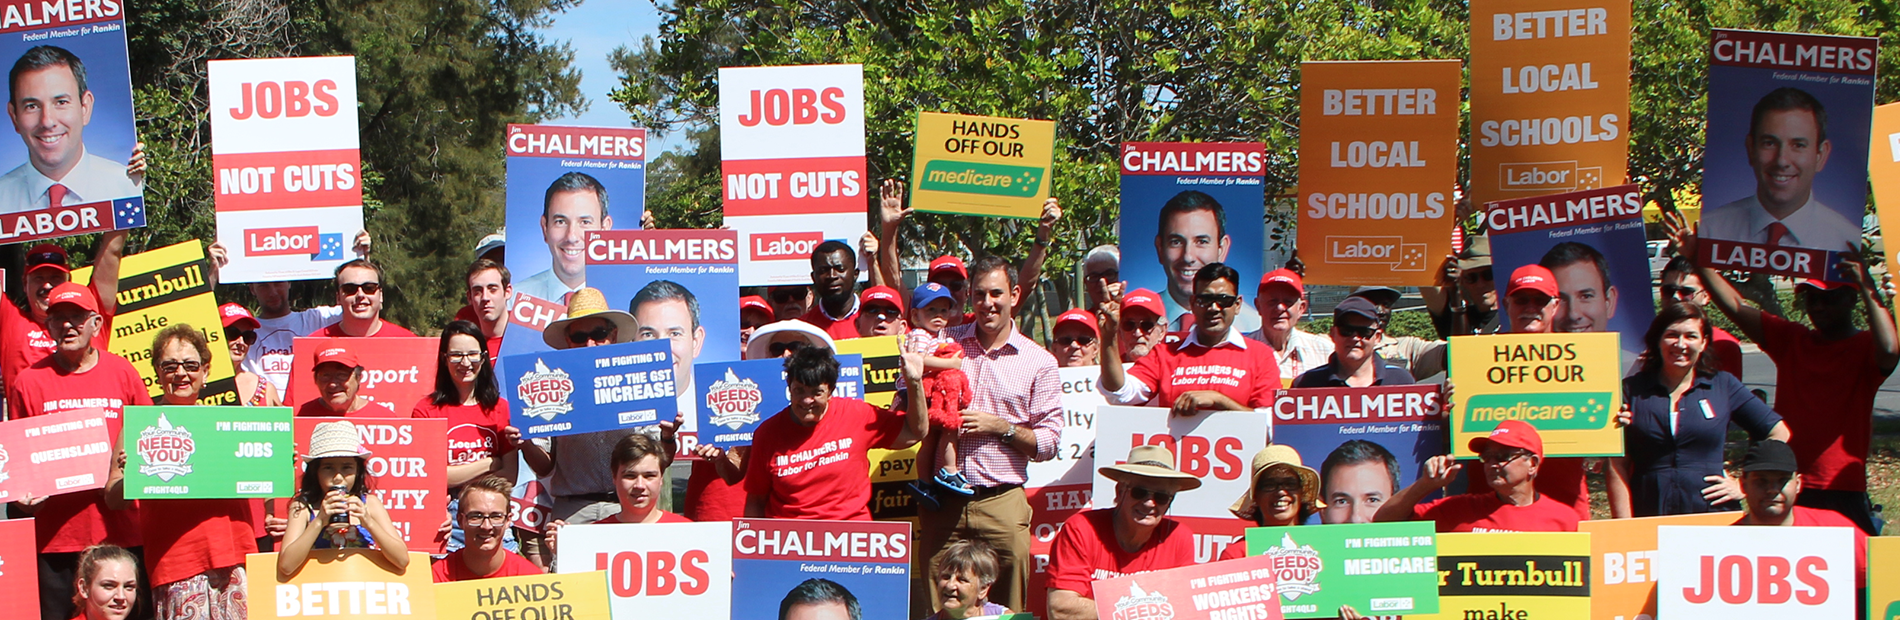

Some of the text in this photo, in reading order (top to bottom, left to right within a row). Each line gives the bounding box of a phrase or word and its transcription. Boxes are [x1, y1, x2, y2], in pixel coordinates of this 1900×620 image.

[23, 24, 120, 41] Federal Member for Rankin
[1493, 8, 1607, 41] BETTER
[1716, 32, 1728, 40] Jim
[1714, 40, 1872, 70] CHALMERS
[1502, 63, 1598, 94] LOCAL
[1772, 72, 1870, 86] Federal Member for Rankin
[229, 79, 339, 120] JOBS
[738, 86, 846, 128] JOBS
[1323, 88, 1436, 116] BETTER
[510, 126, 522, 134] Jim
[952, 120, 1020, 139] HANDS
[1480, 114, 1618, 147] SCHOOLS
[509, 133, 644, 158] CHALMERS
[945, 138, 1024, 158] OFF OUR
[1125, 144, 1136, 152] Jim
[1330, 141, 1426, 168] LOCAL
[561, 160, 642, 170] Federal Member for Rankin
[1123, 151, 1262, 172] CHALMERS
[220, 163, 355, 195] NOT CUTS
[928, 168, 1012, 188] medicare
[1176, 177, 1198, 185] Federal
[1199, 177, 1225, 185] Member
[1226, 177, 1235, 186] for
[1507, 165, 1570, 186] Labor
[728, 170, 860, 201] NOT CUTS
[1308, 192, 1444, 220] SCHOOLS
[1488, 202, 1499, 210] Jim
[1488, 192, 1640, 231] CHALMERS
[0, 207, 101, 240] LABOR
[1549, 221, 1642, 238] Federal Member for Rankin
[250, 232, 312, 252] Labor
[589, 232, 600, 242] Jim
[756, 233, 817, 257] Labor
[588, 239, 735, 261] CHALMERS
[1333, 239, 1394, 258] Labor
[1711, 244, 1811, 274] LABOR
[645, 266, 734, 275] Federal Member for Rankin
[116, 264, 205, 305] urnbull
[520, 293, 531, 301] Jim
[115, 314, 168, 338] make
[262, 346, 293, 356] Local
[595, 352, 666, 368] I'M FIGHTING TO
[1493, 343, 1577, 362] HANDS
[262, 358, 290, 372] Lab
[841, 367, 860, 377] FOR
[1186, 365, 1246, 378] CHALMERS MP
[1487, 365, 1584, 384] OFF OUR
[520, 380, 571, 396] NEEDS
[594, 369, 672, 388] STOP THE GST
[1172, 376, 1239, 387] Labor for Rankin
[528, 392, 564, 405] YOU!
[594, 381, 674, 405] INCREASE
[708, 389, 759, 404] NEEDS
[1276, 389, 1288, 398] Jim
[44, 402, 58, 412] JIM
[59, 399, 109, 410] CHALMERS
[716, 402, 752, 414] YOU!
[1274, 392, 1441, 420] CHALMERS
[1471, 402, 1574, 422] medicare
[216, 422, 290, 432] I'M FIGHTING FOR
[621, 414, 644, 422] Labor
[25, 418, 104, 438] I'M FIGHTING FOR
[529, 422, 572, 434] #FIGHT4QLD
[1339, 424, 1440, 435] Federal Member for Rankin
[139, 436, 193, 452] NEEDS
[715, 433, 753, 443] #FIGHT4QL
[30, 442, 108, 464] QUEENSLAND
[147, 450, 184, 463] YOU!
[234, 442, 273, 458] JOBS
[776, 438, 852, 466] IM CHALMERS MP
[1070, 444, 1082, 459] 2
[778, 452, 849, 476] Labor for Rankin
[879, 458, 915, 477] pay
[143, 486, 189, 494] #FIGHT4QLD
[874, 490, 912, 514] fair
[737, 521, 750, 530] Jim
[735, 530, 906, 558] CHALMERS
[1345, 536, 1432, 548] I'M FIGHTING FOR
[800, 564, 905, 575] Federal Member for Rankin
[1273, 556, 1320, 570] EEDS
[1344, 557, 1435, 575] MEDICARE
[1604, 550, 1658, 585] BET
[1091, 568, 1108, 580] JIM
[1190, 568, 1270, 589] I'M FIGHTING FOR
[1458, 562, 1583, 588] Turnbull
[1682, 554, 1829, 606] JOBS
[276, 582, 412, 617] BETTER
[476, 582, 564, 606] HANDS
[1192, 582, 1274, 611] WORKERS'
[521, 604, 573, 620] OUR
[1114, 604, 1172, 620] NEEDS
[1210, 604, 1268, 620] RIGHTS
[1373, 600, 1398, 608] Labor
[1464, 602, 1528, 620] make
